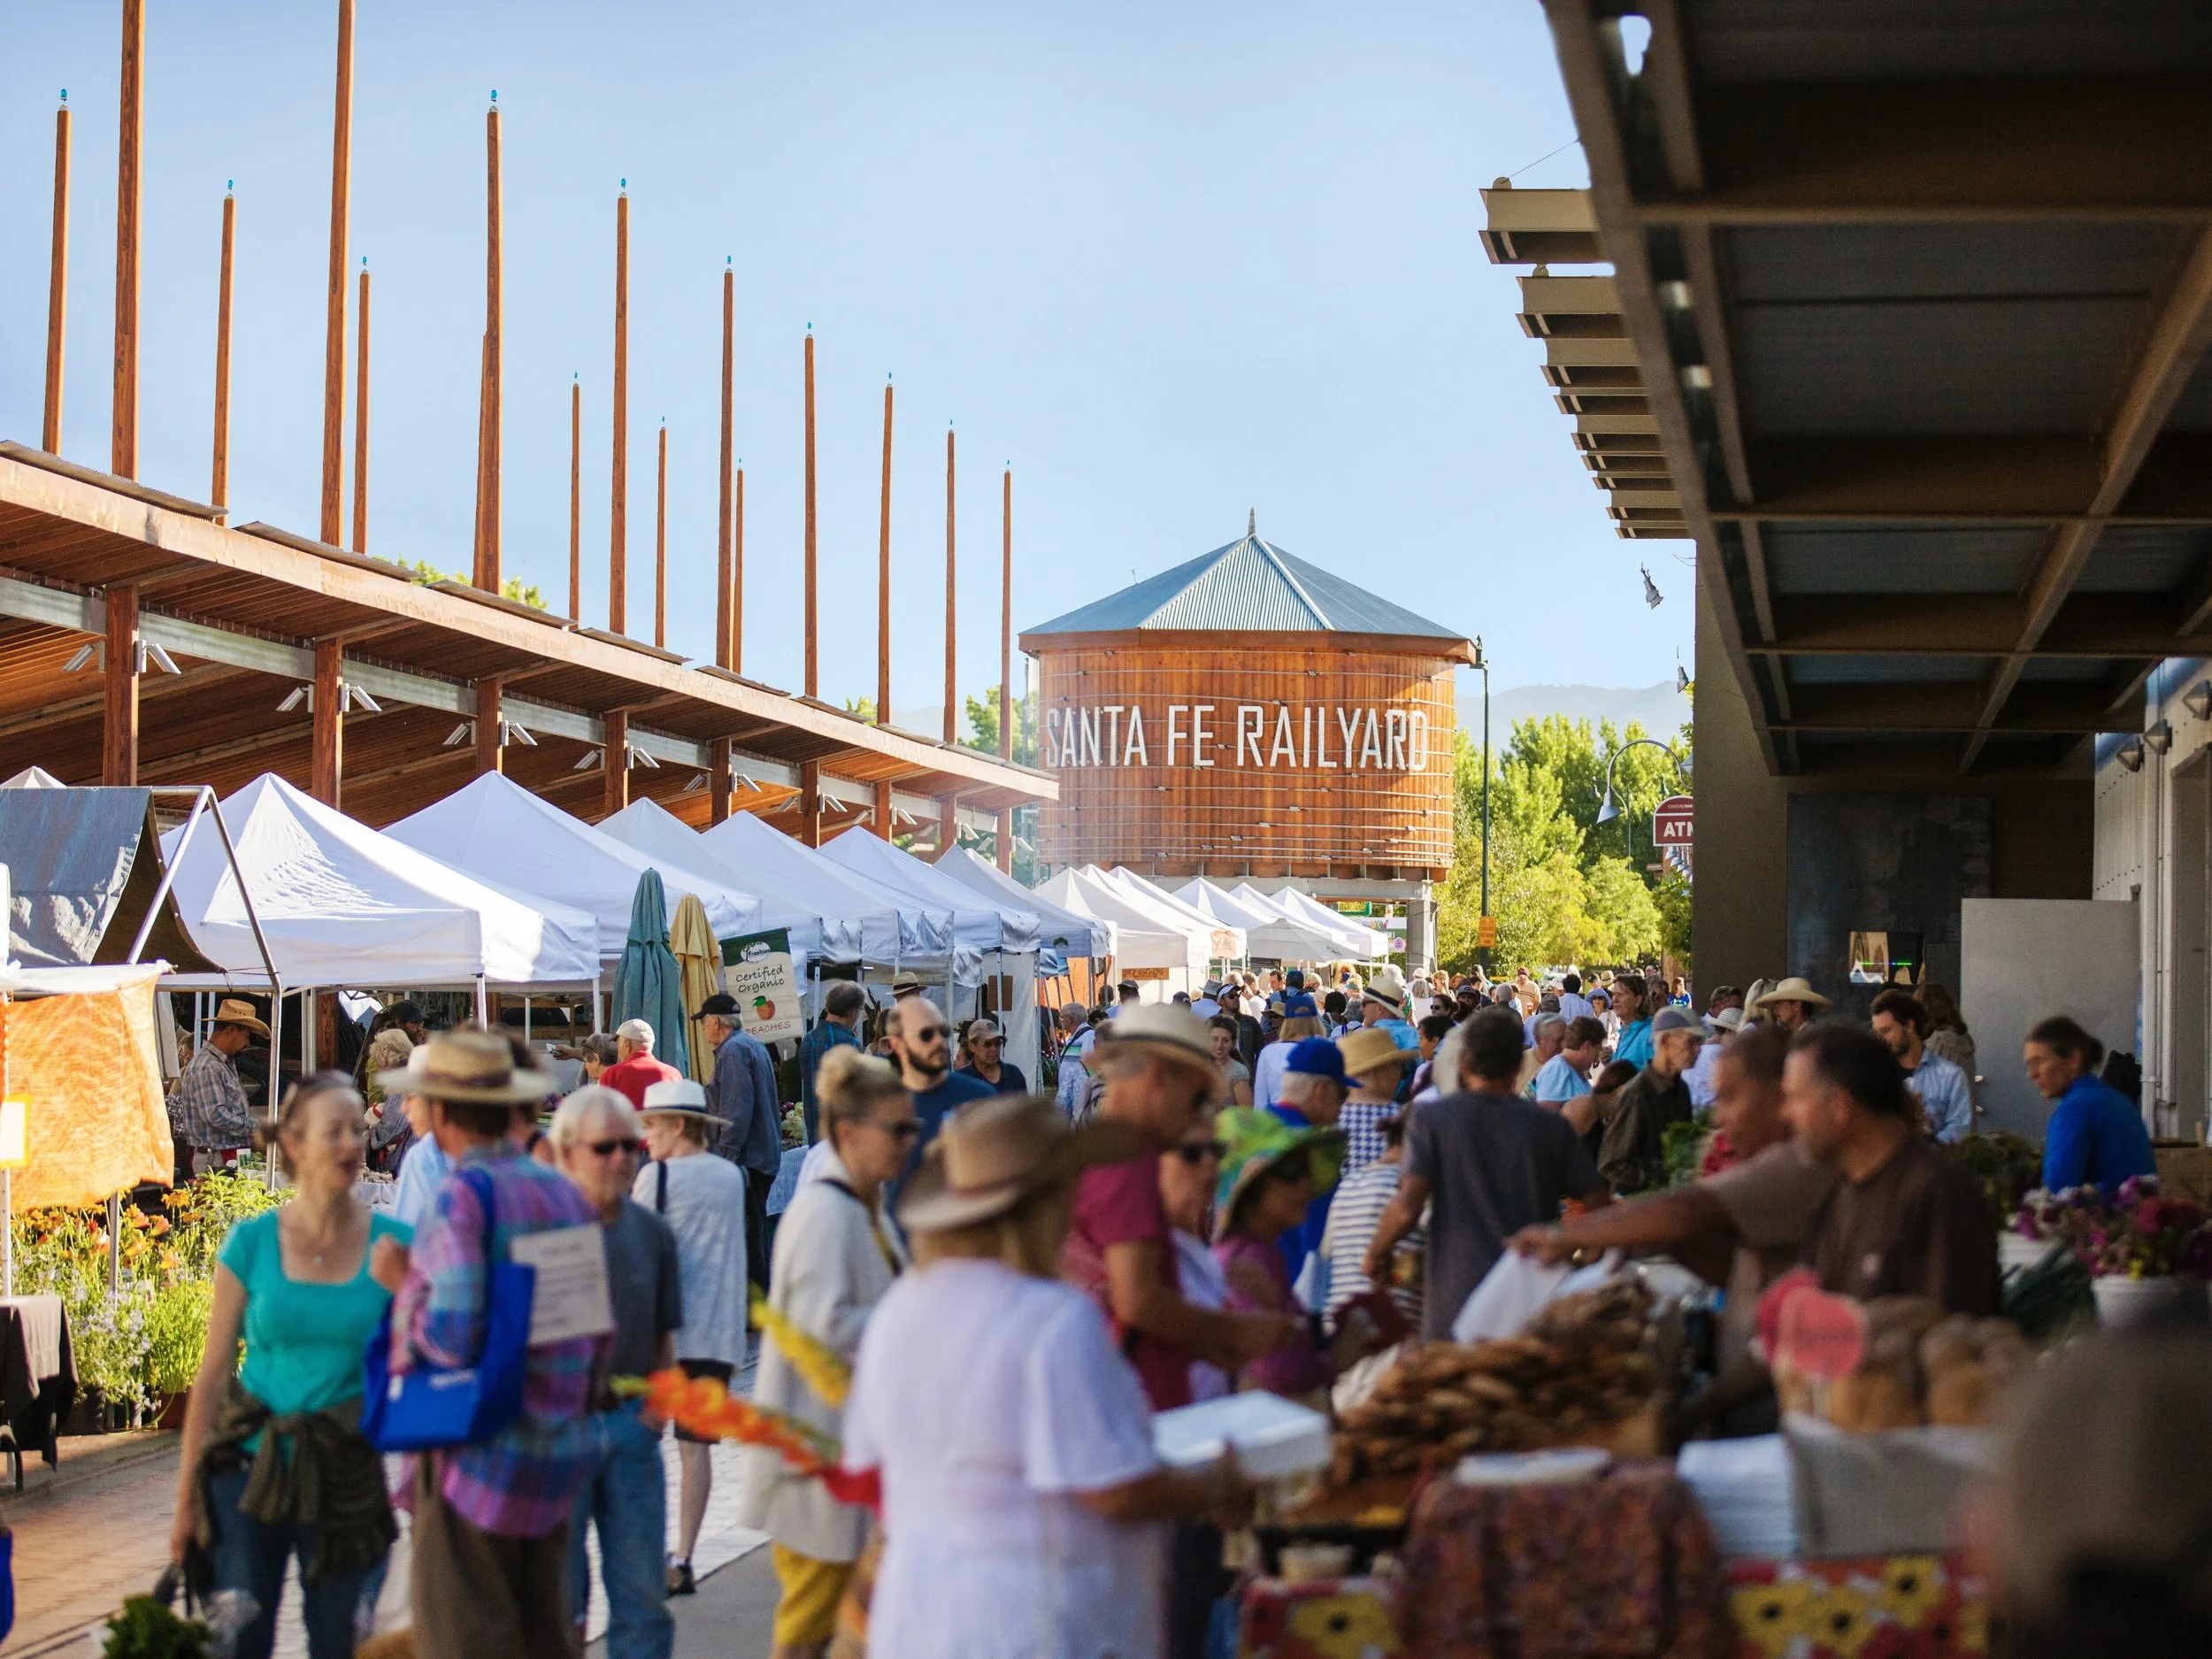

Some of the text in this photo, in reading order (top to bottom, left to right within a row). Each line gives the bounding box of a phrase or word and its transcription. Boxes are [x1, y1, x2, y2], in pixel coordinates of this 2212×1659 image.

[1047, 704, 1429, 772] SANTA FE RAILYARD
[735, 964, 783, 982] Certified
[745, 1021, 791, 1034] PEACHES
